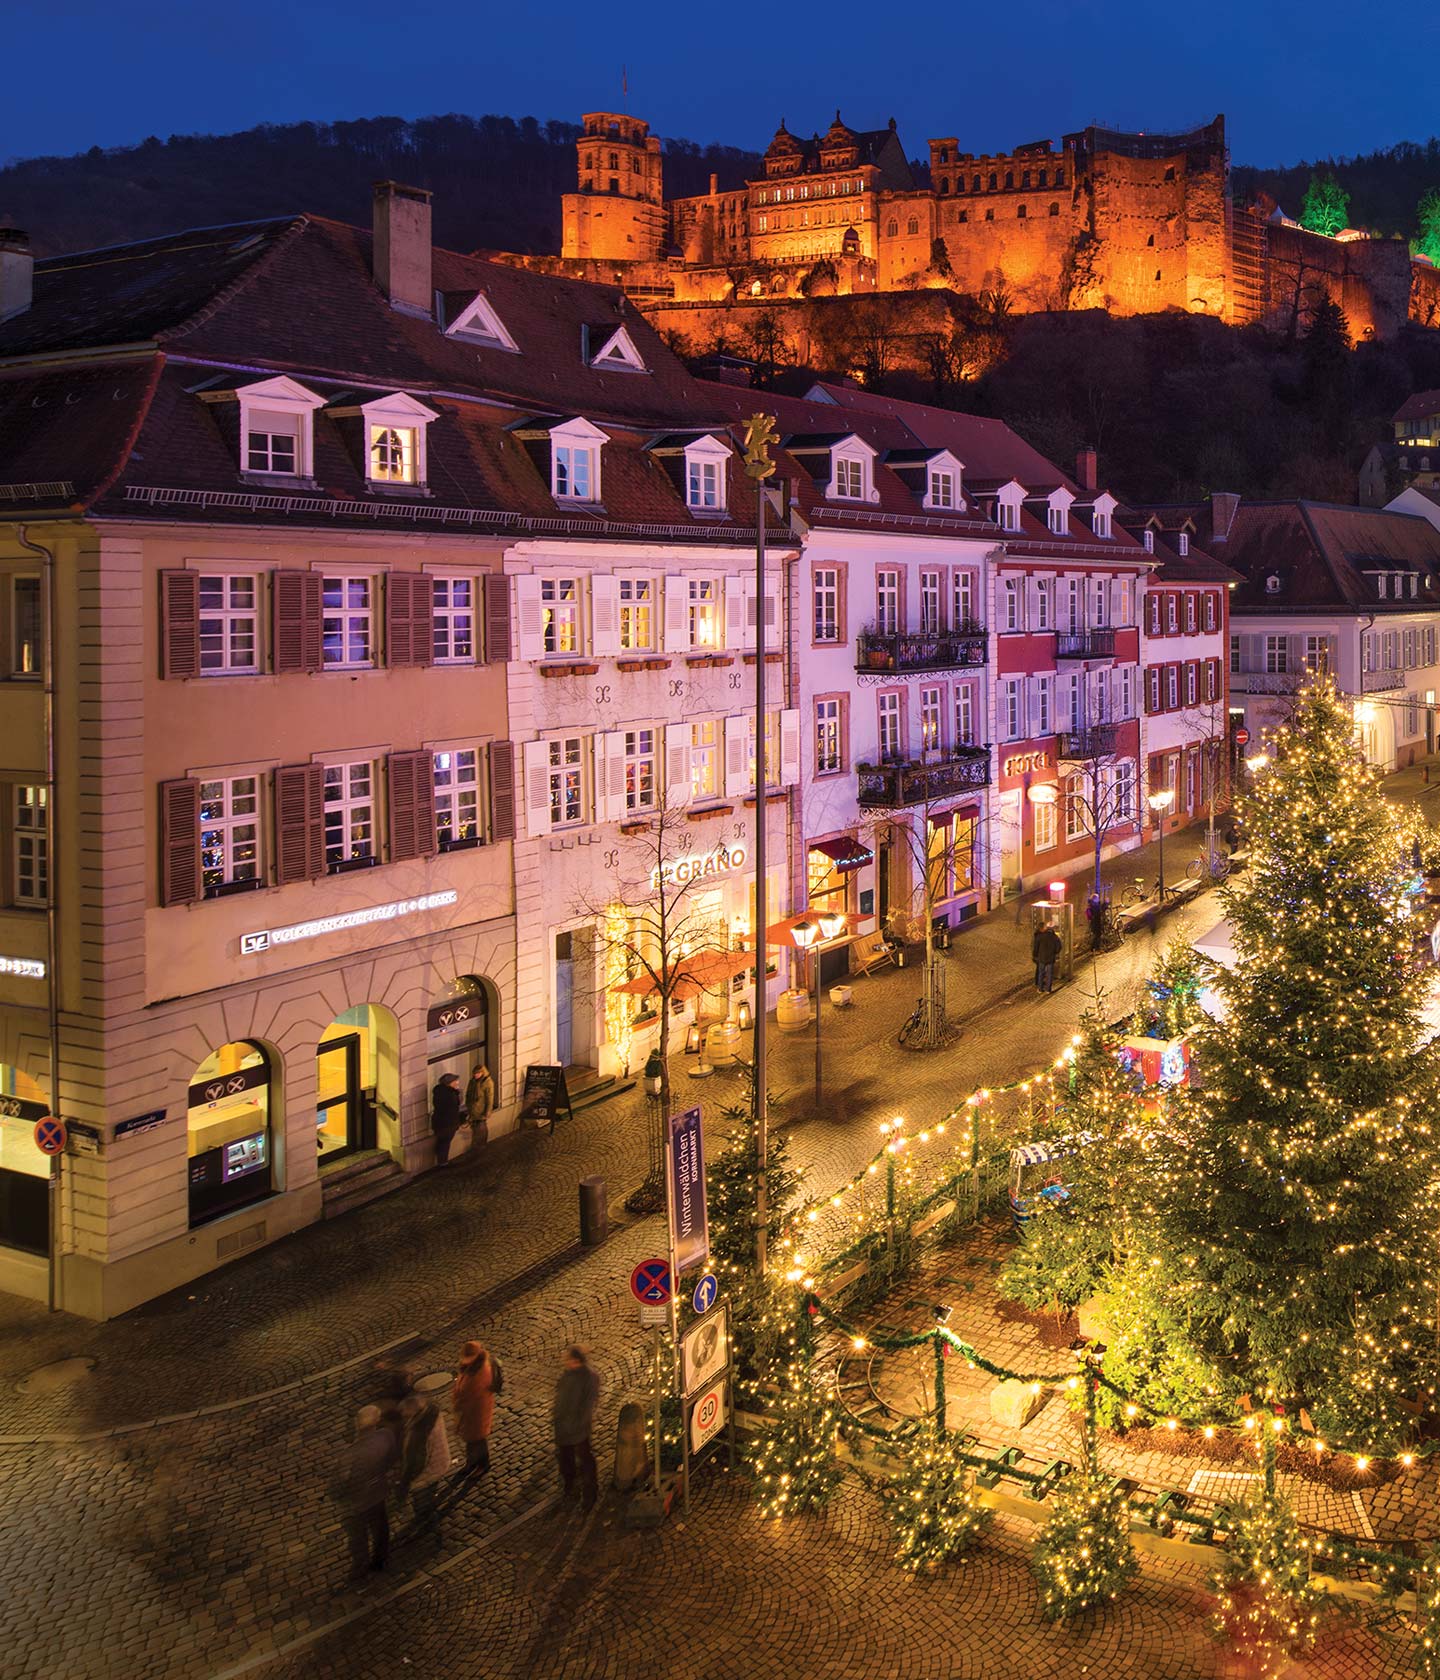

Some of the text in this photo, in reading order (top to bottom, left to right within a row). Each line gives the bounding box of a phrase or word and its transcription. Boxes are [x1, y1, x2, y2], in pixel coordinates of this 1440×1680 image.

[1006, 752, 1052, 777] HOTEL
[676, 849, 746, 882] GRANO
[690, 1129, 698, 1183] KORNMARKT
[679, 1132, 693, 1238] Winterwäldchen
[701, 1400, 714, 1422] 30
[701, 1423, 718, 1444] ZONE
